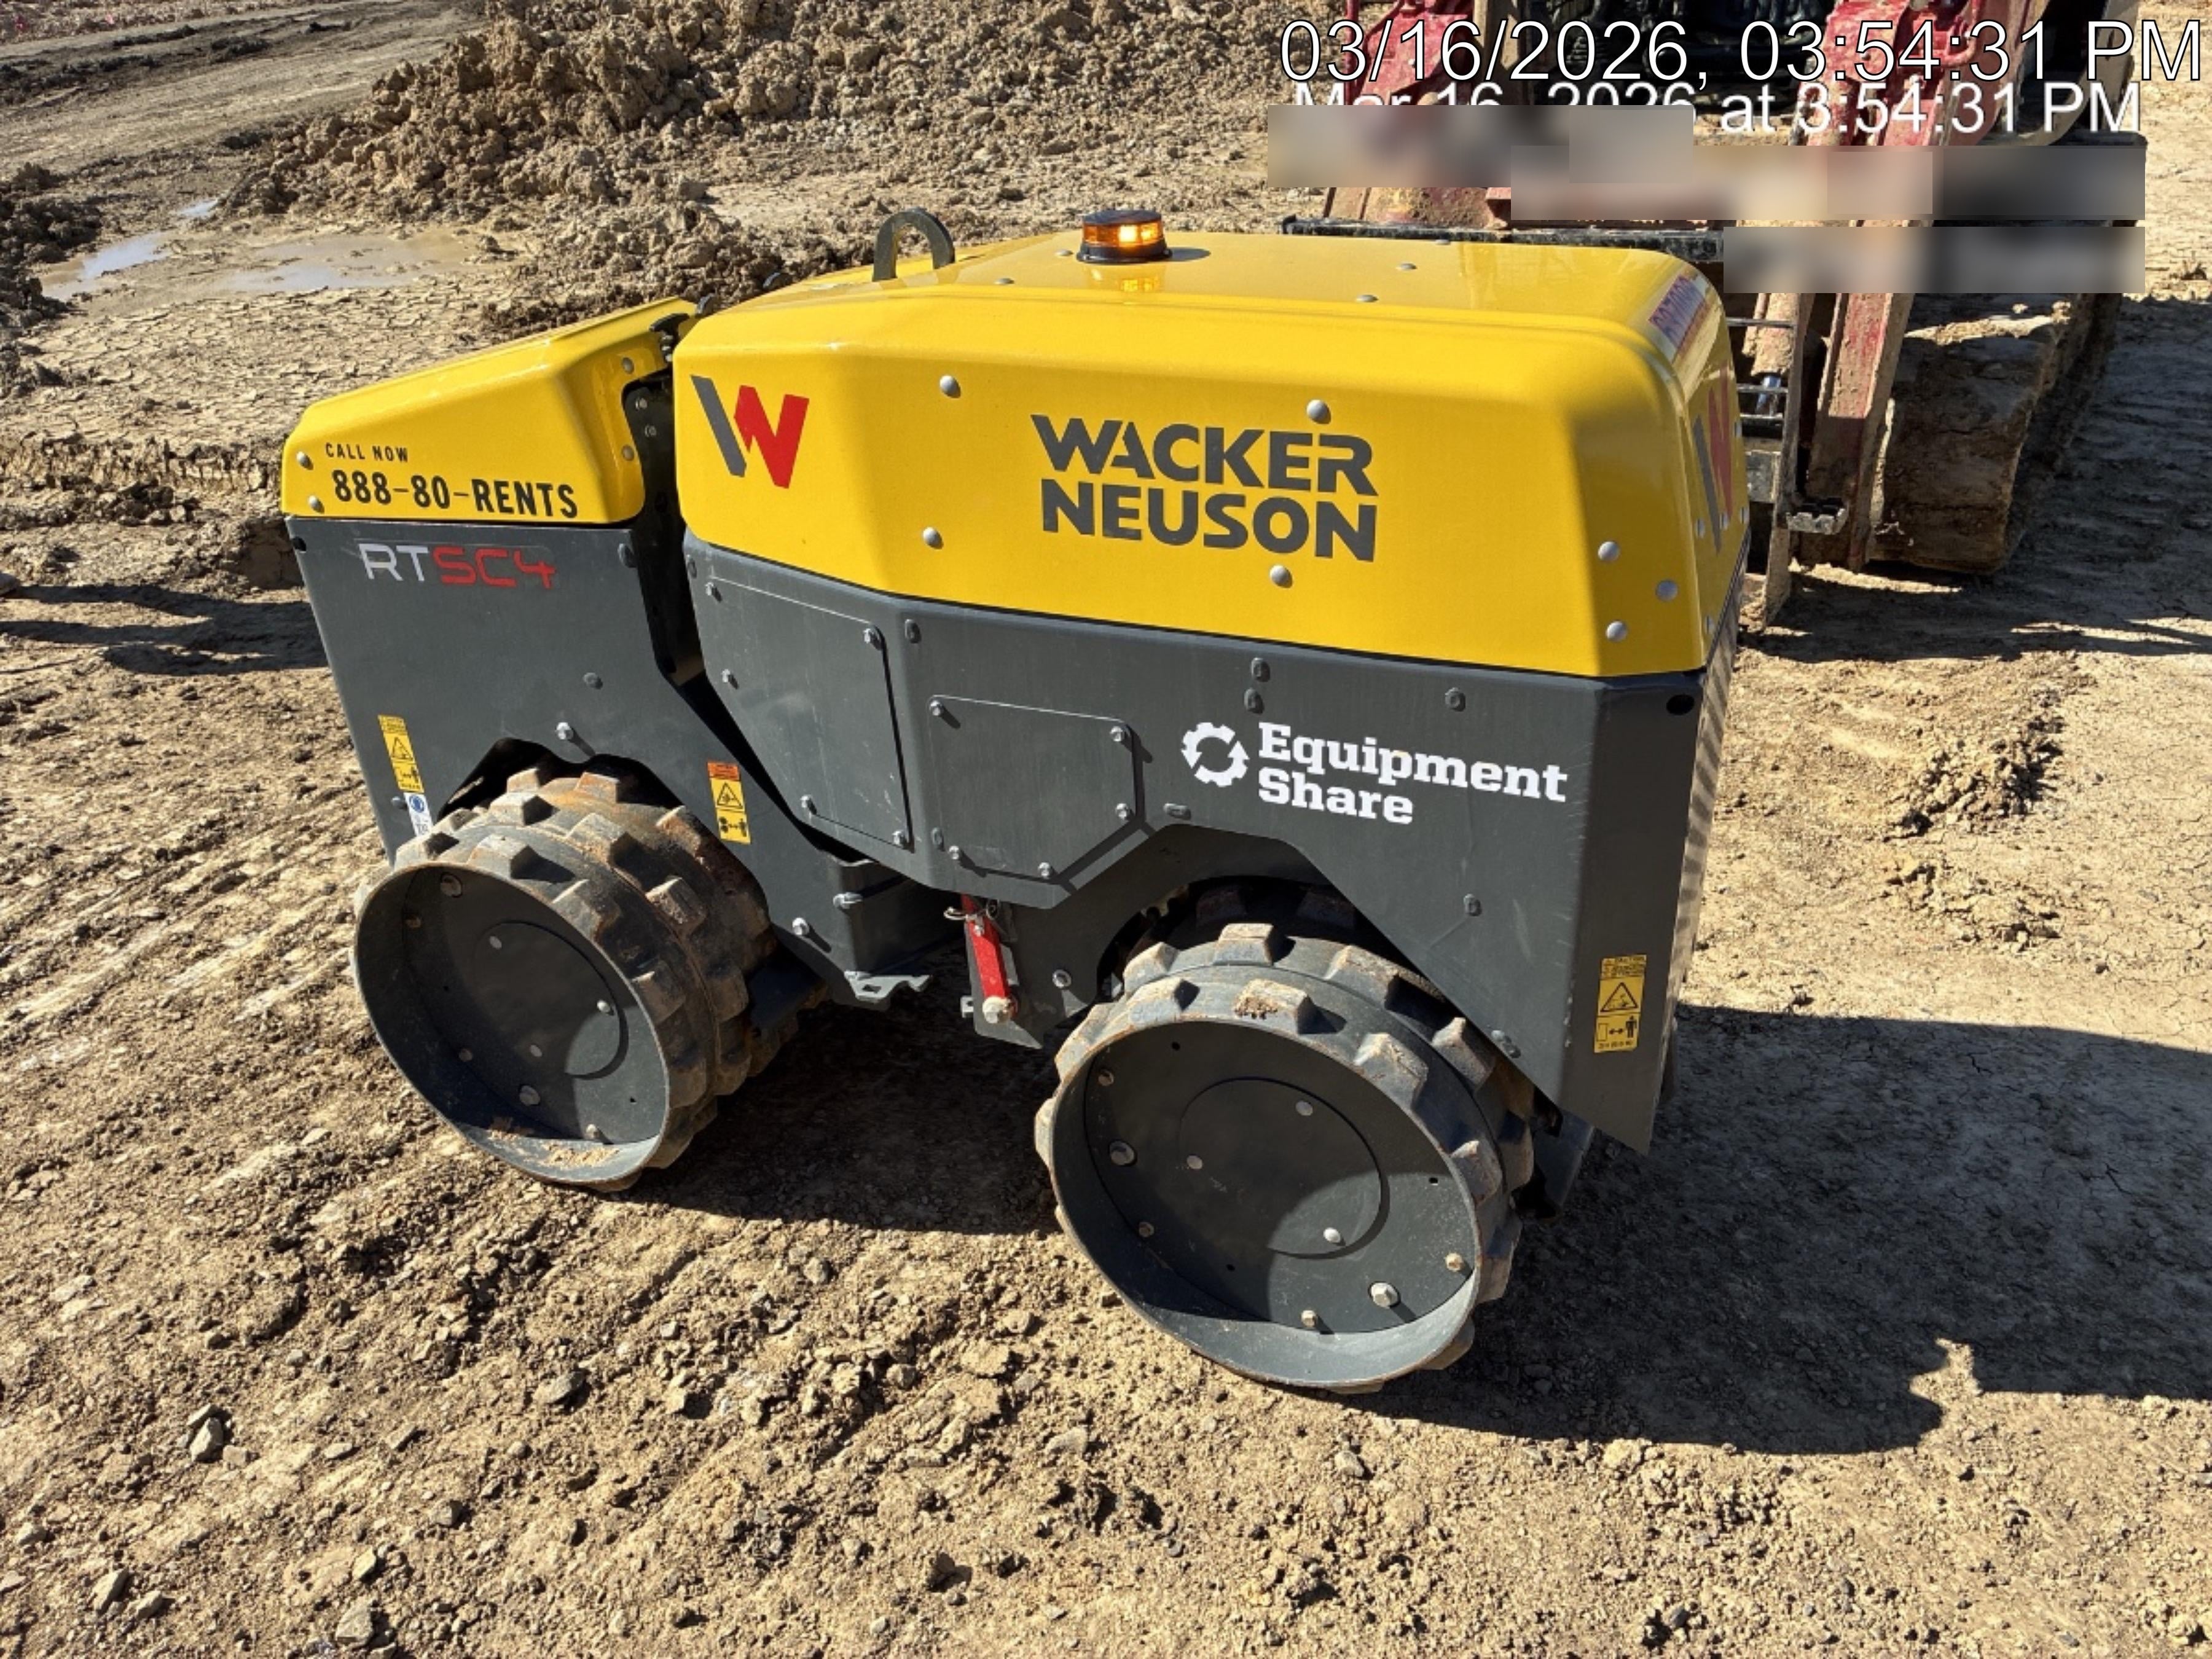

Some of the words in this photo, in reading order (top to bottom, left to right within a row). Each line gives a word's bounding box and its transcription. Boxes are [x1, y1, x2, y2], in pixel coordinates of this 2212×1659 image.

[325, 442, 365, 460] CALL
[373, 446, 409, 462] NOW
[1030, 414, 1379, 496] WACKER
[331, 469, 578, 519] 888-80-RENTS
[1041, 478, 1377, 563] NEUSON
[359, 543, 555, 589] RTSC4
[1258, 721, 1568, 802] Equipment
[1258, 766, 1413, 825] Share
